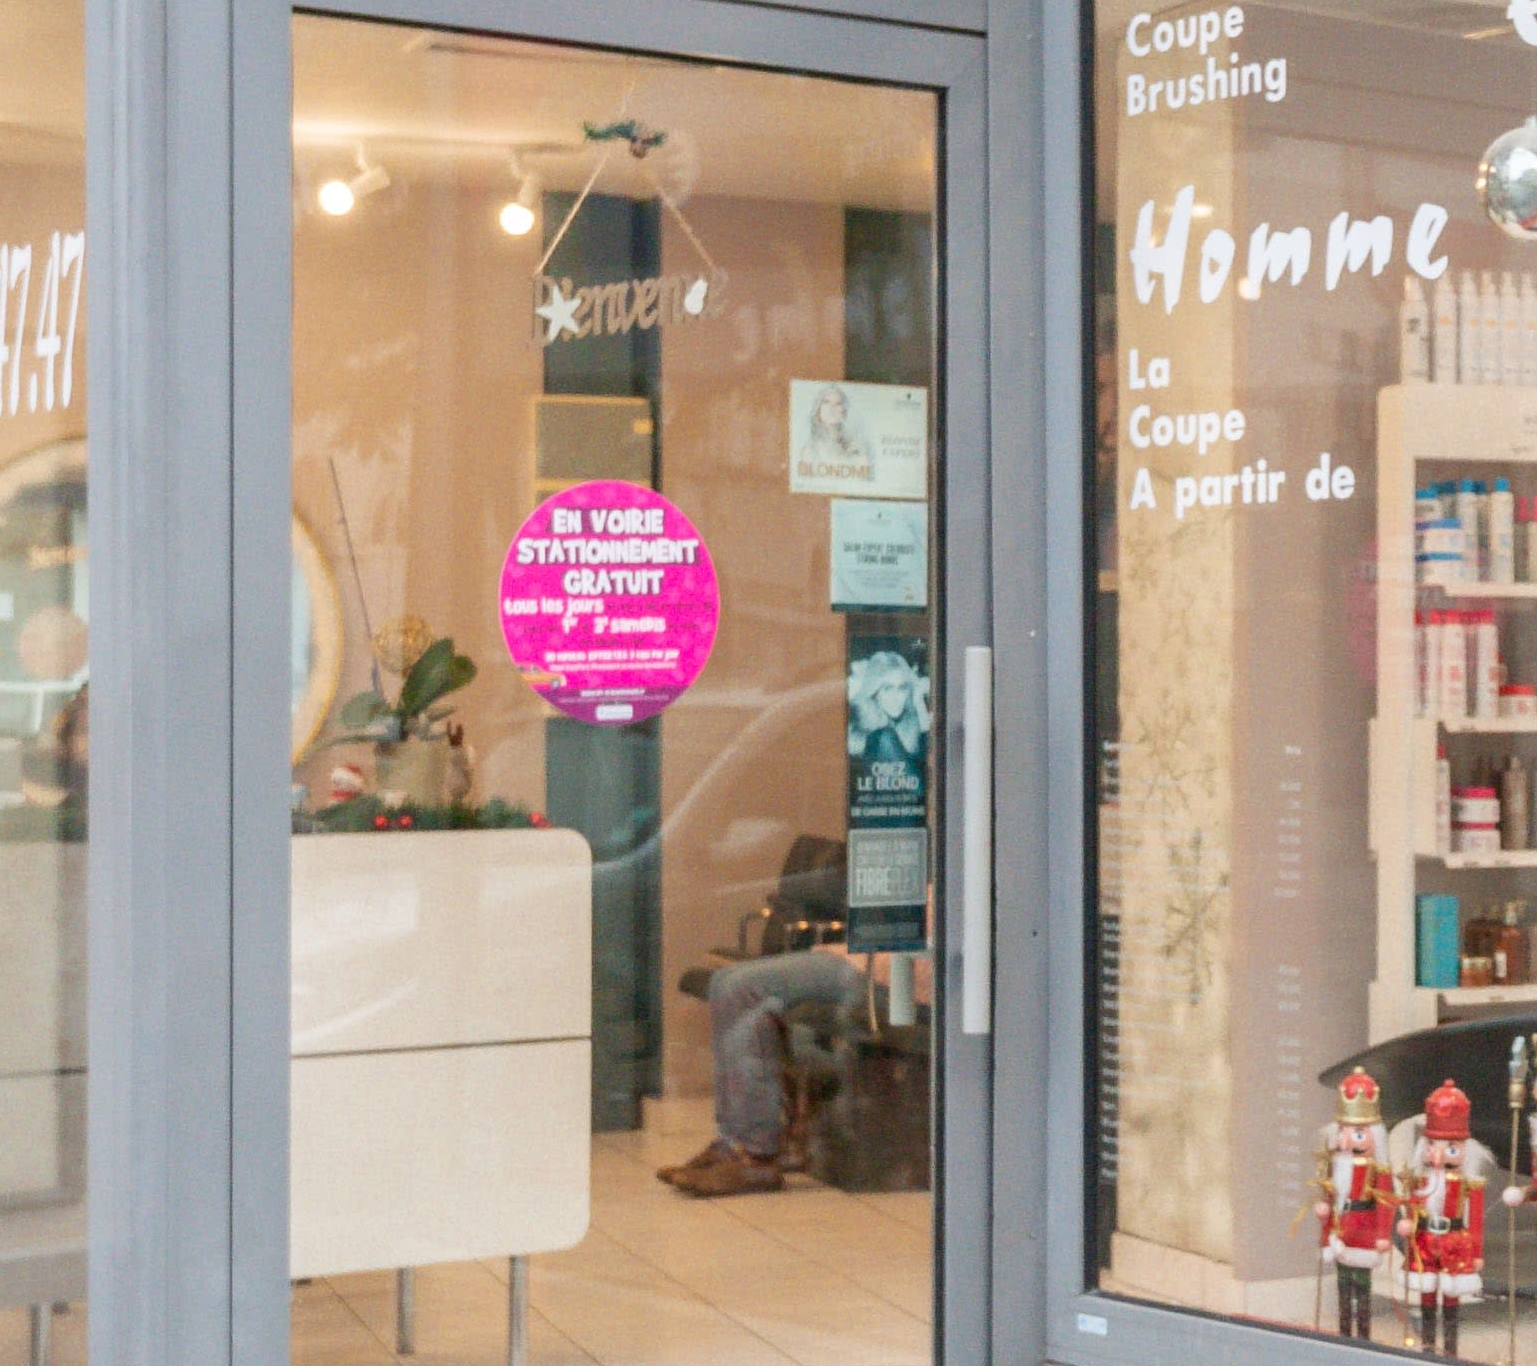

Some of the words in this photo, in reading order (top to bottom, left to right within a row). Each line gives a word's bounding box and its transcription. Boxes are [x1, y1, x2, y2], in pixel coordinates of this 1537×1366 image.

[1126, 5, 1245, 58] Coupe
[1126, 53, 1288, 117] Brushing
[1129, 184, 1450, 315] Homme
[1128, 348, 1171, 390] La
[1128, 405, 1247, 455] Coupe
[1129, 467, 1157, 510] A
[1175, 459, 1286, 520] partir
[1305, 452, 1356, 502] de
[552, 508, 582, 533] EN
[590, 508, 664, 533] VOIRIE
[516, 538, 699, 564] STATIONNEMENT
[564, 569, 664, 594] GRATUIT
[504, 599, 538, 615] tous
[541, 597, 563, 614] les
[565, 597, 604, 618] jours
